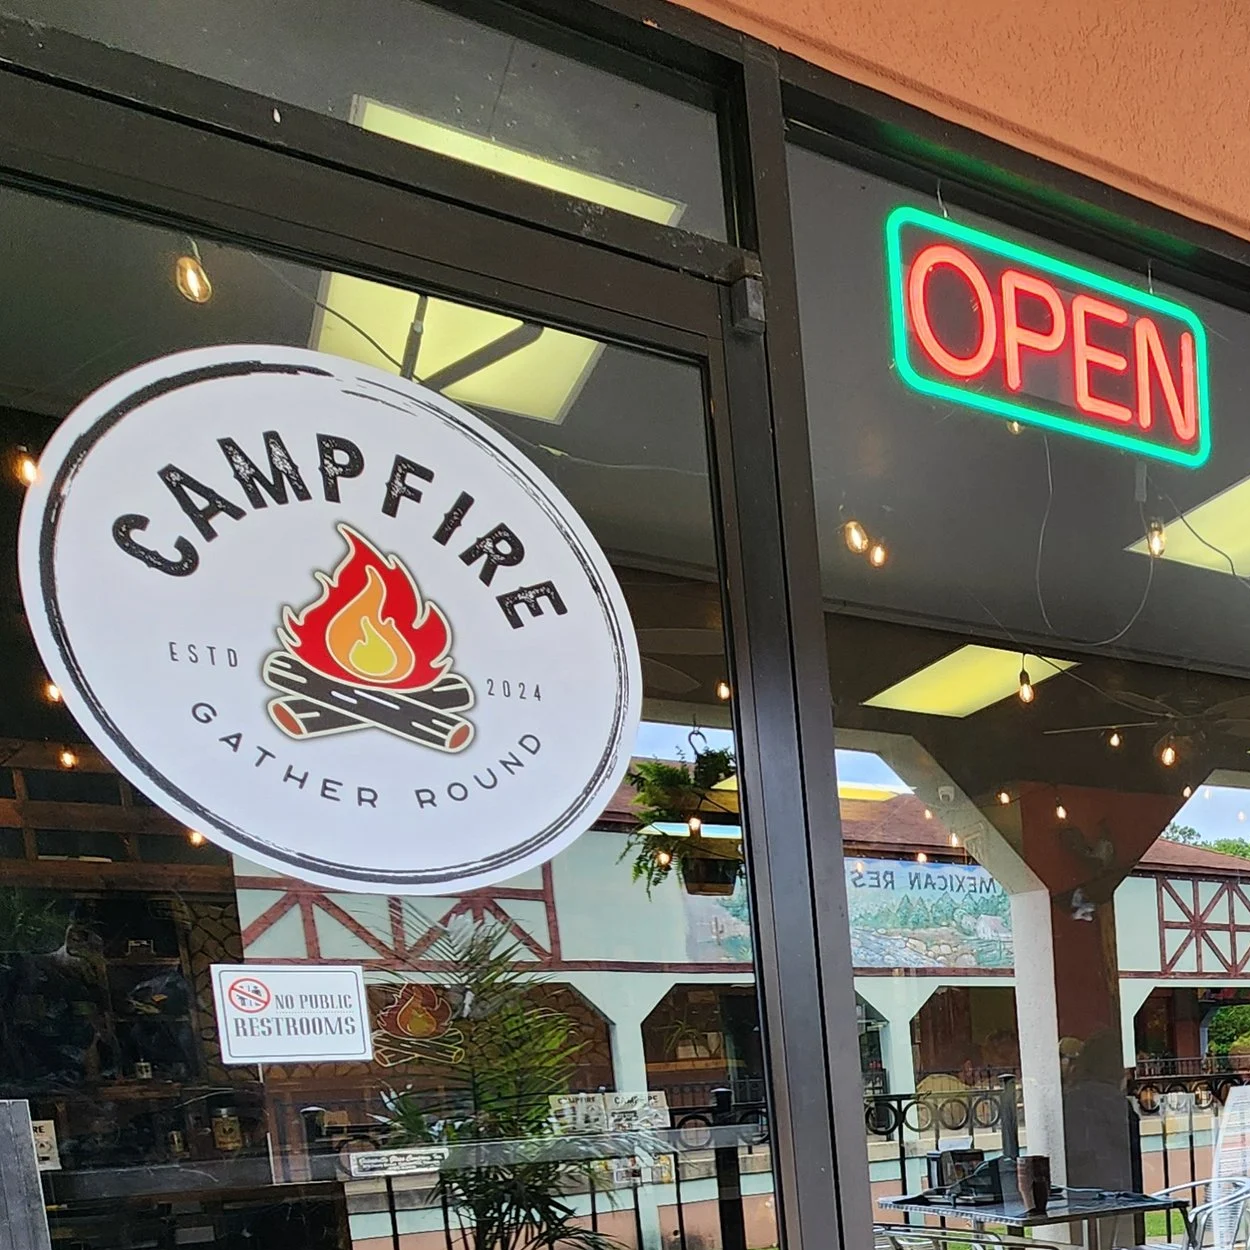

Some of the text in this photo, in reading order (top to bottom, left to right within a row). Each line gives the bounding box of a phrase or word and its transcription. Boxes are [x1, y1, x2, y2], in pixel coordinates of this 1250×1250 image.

[907, 243, 1198, 443] OPEN
[112, 430, 568, 629] CAMPFIRE
[169, 641, 543, 702] ESTD 2024
[191, 702, 542, 809] GATHER ROUND
[233, 1016, 356, 1037] RESTROOMS
[275, 994, 353, 1010] NO PUBLIC
